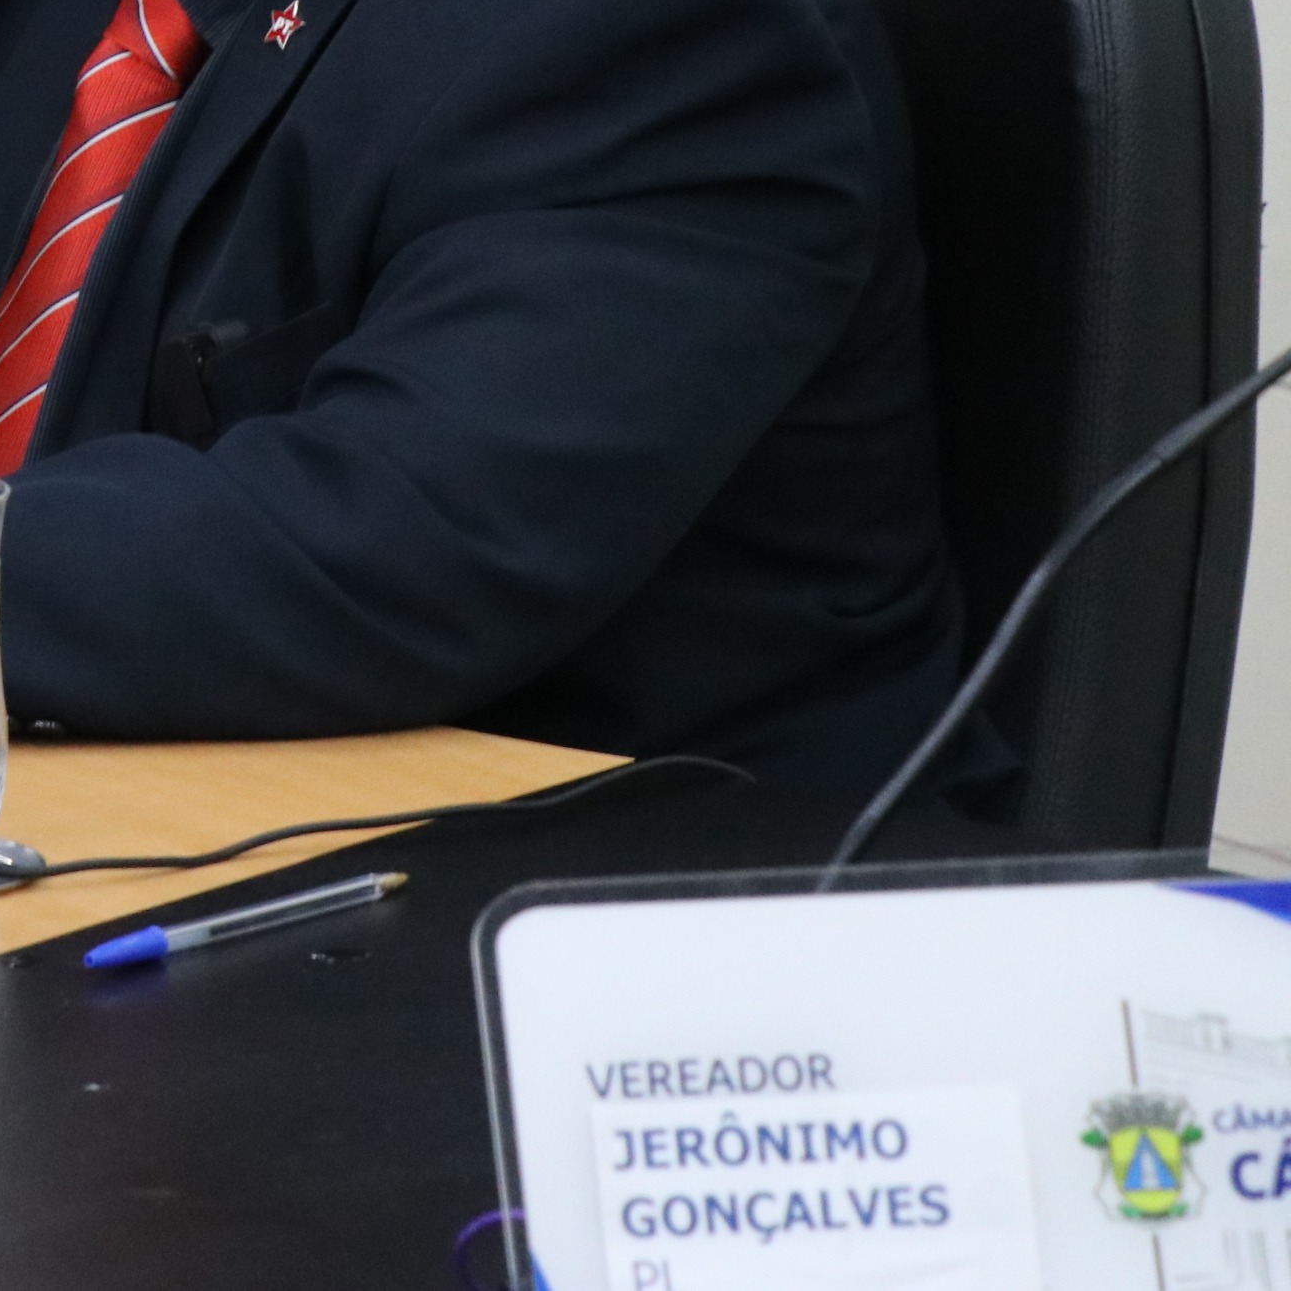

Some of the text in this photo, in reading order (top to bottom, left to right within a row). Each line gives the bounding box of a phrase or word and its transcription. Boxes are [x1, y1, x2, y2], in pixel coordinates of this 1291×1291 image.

[273, 16, 295, 35] PT
[586, 1054, 836, 1100] VEREADOR
[613, 1110, 908, 1171] JERÔNIMO
[621, 1184, 952, 1245] GONÇALVES
